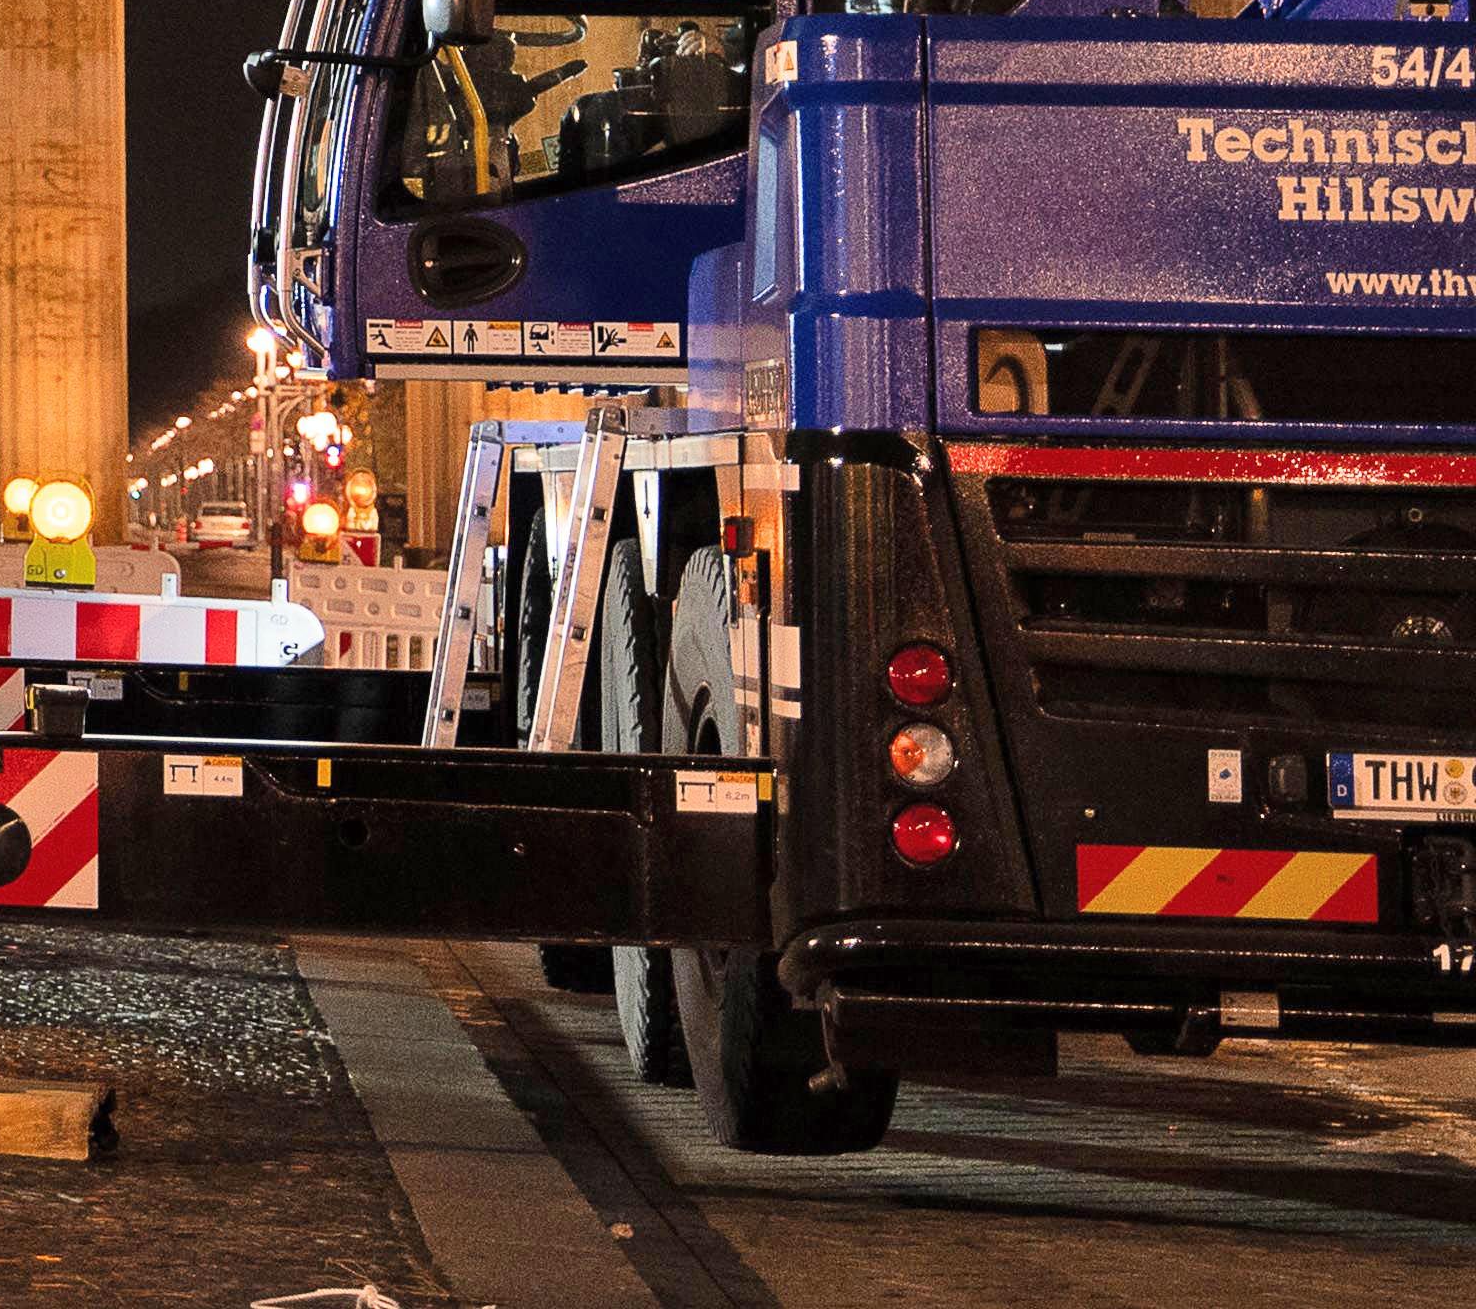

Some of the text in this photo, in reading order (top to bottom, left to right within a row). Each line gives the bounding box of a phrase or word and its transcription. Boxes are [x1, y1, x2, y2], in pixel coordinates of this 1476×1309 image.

[1277, 177, 1476, 223] Hilfsw
[1337, 785, 1347, 797] D
[1365, 760, 1438, 801] THW
